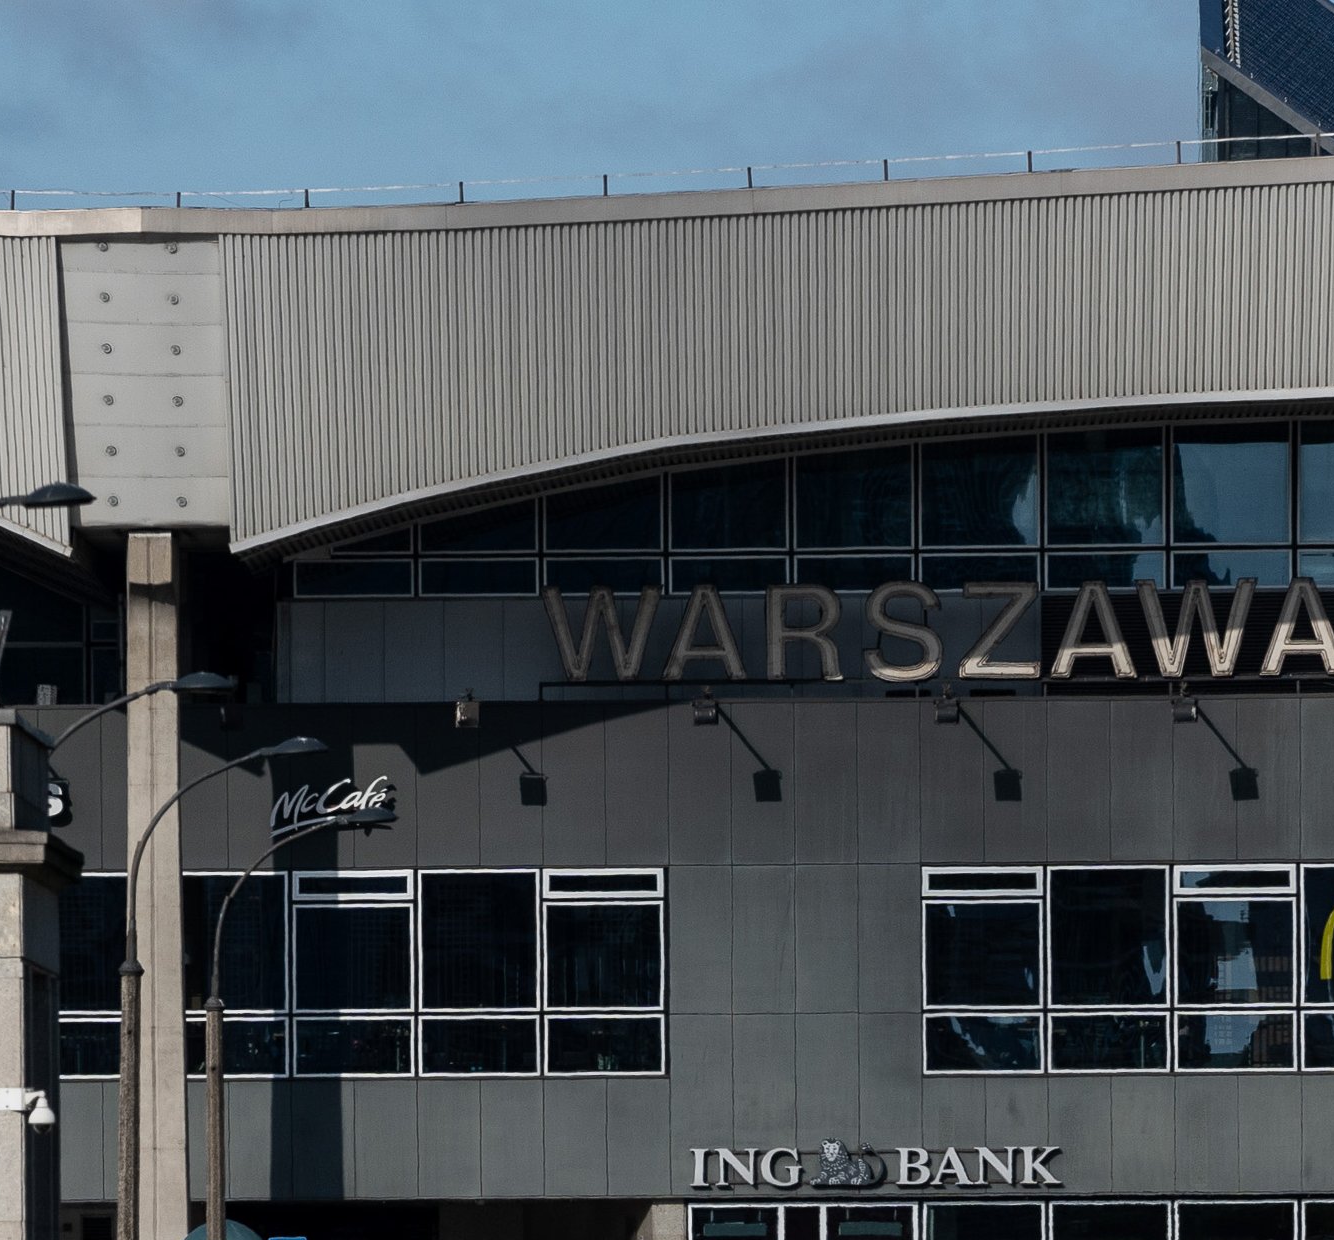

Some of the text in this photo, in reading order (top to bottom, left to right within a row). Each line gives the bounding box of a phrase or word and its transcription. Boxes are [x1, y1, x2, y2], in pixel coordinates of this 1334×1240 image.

[270, 775, 388, 831] McCafé
[689, 1146, 1064, 1188] ING BANK
